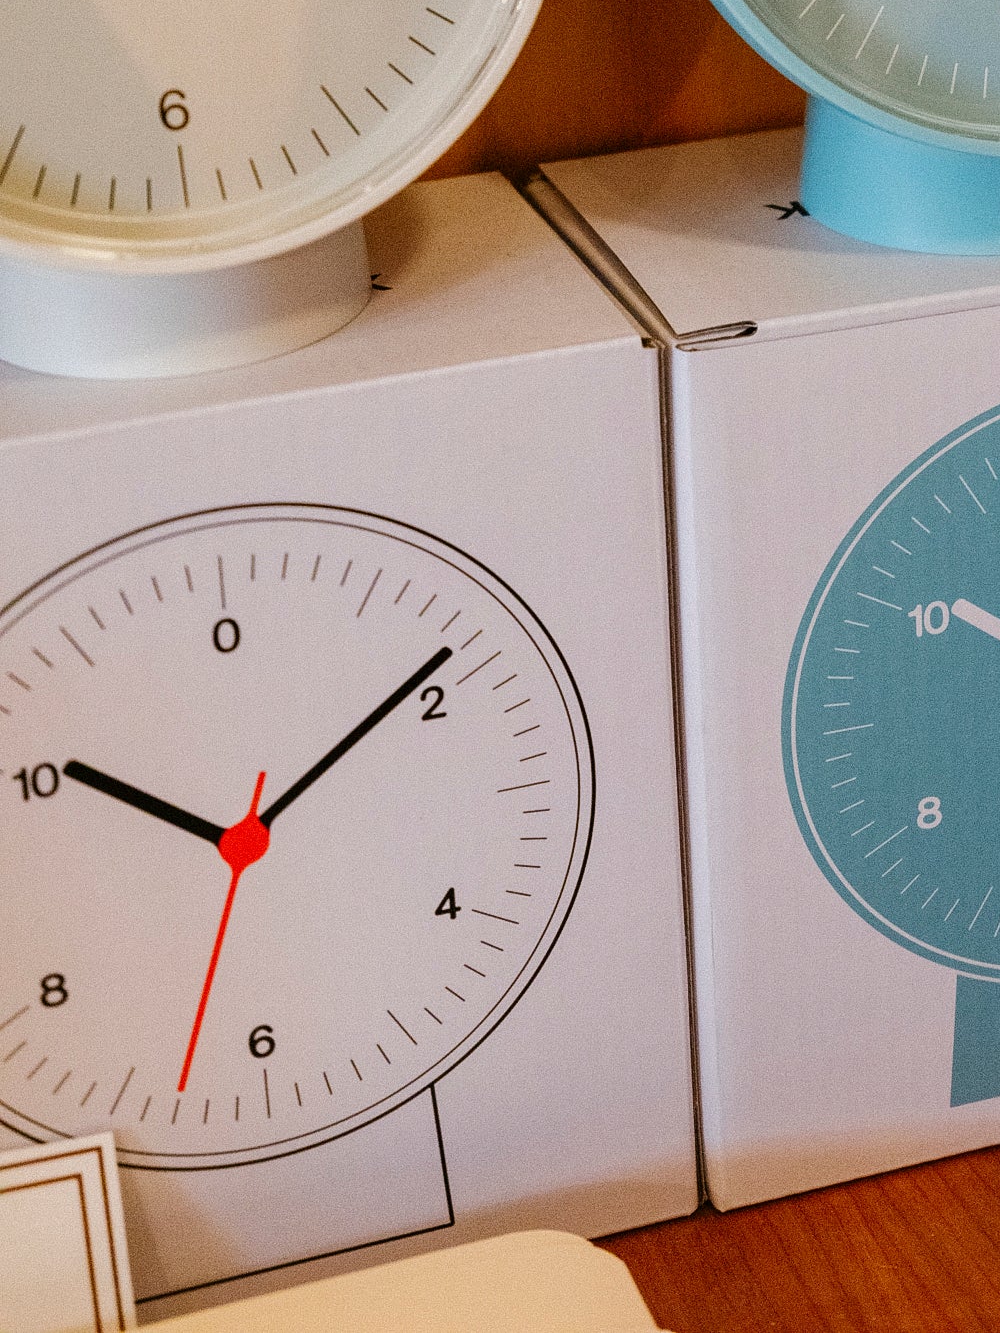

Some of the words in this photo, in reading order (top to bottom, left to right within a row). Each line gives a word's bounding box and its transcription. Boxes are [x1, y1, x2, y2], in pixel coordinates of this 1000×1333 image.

[158, 89, 190, 132] 6
[212, 617, 241, 654] 0
[908, 600, 950, 637] 10
[420, 685, 447, 721] 2
[13, 762, 60, 801] 10
[916, 796, 943, 830] 8
[434, 887, 461, 920] 4
[40, 973, 69, 1008] 8
[248, 1024, 276, 1059] 6
